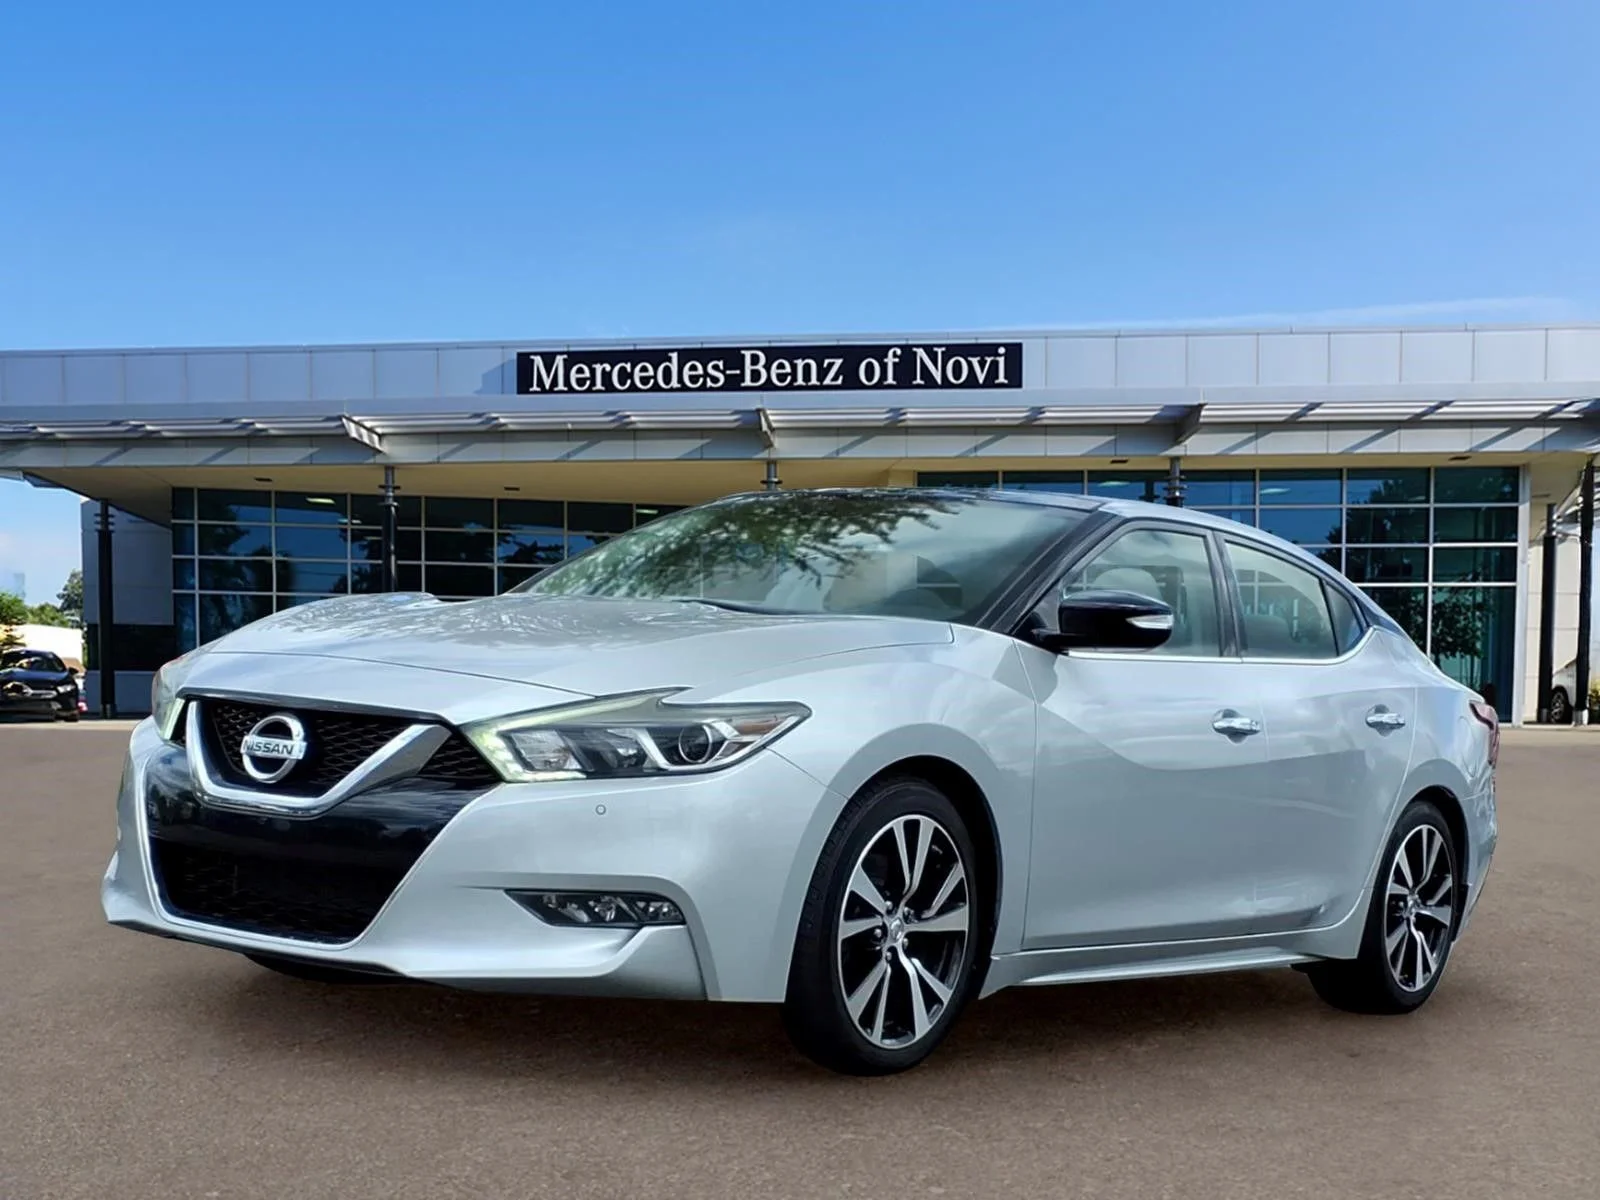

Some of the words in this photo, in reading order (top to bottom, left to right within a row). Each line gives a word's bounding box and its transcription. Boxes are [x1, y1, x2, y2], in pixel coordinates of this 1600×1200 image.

[529, 350, 843, 392] Mercedes-Benz
[858, 347, 902, 387] of
[911, 346, 1009, 386] Novi
[243, 740, 294, 755] NISSAN
